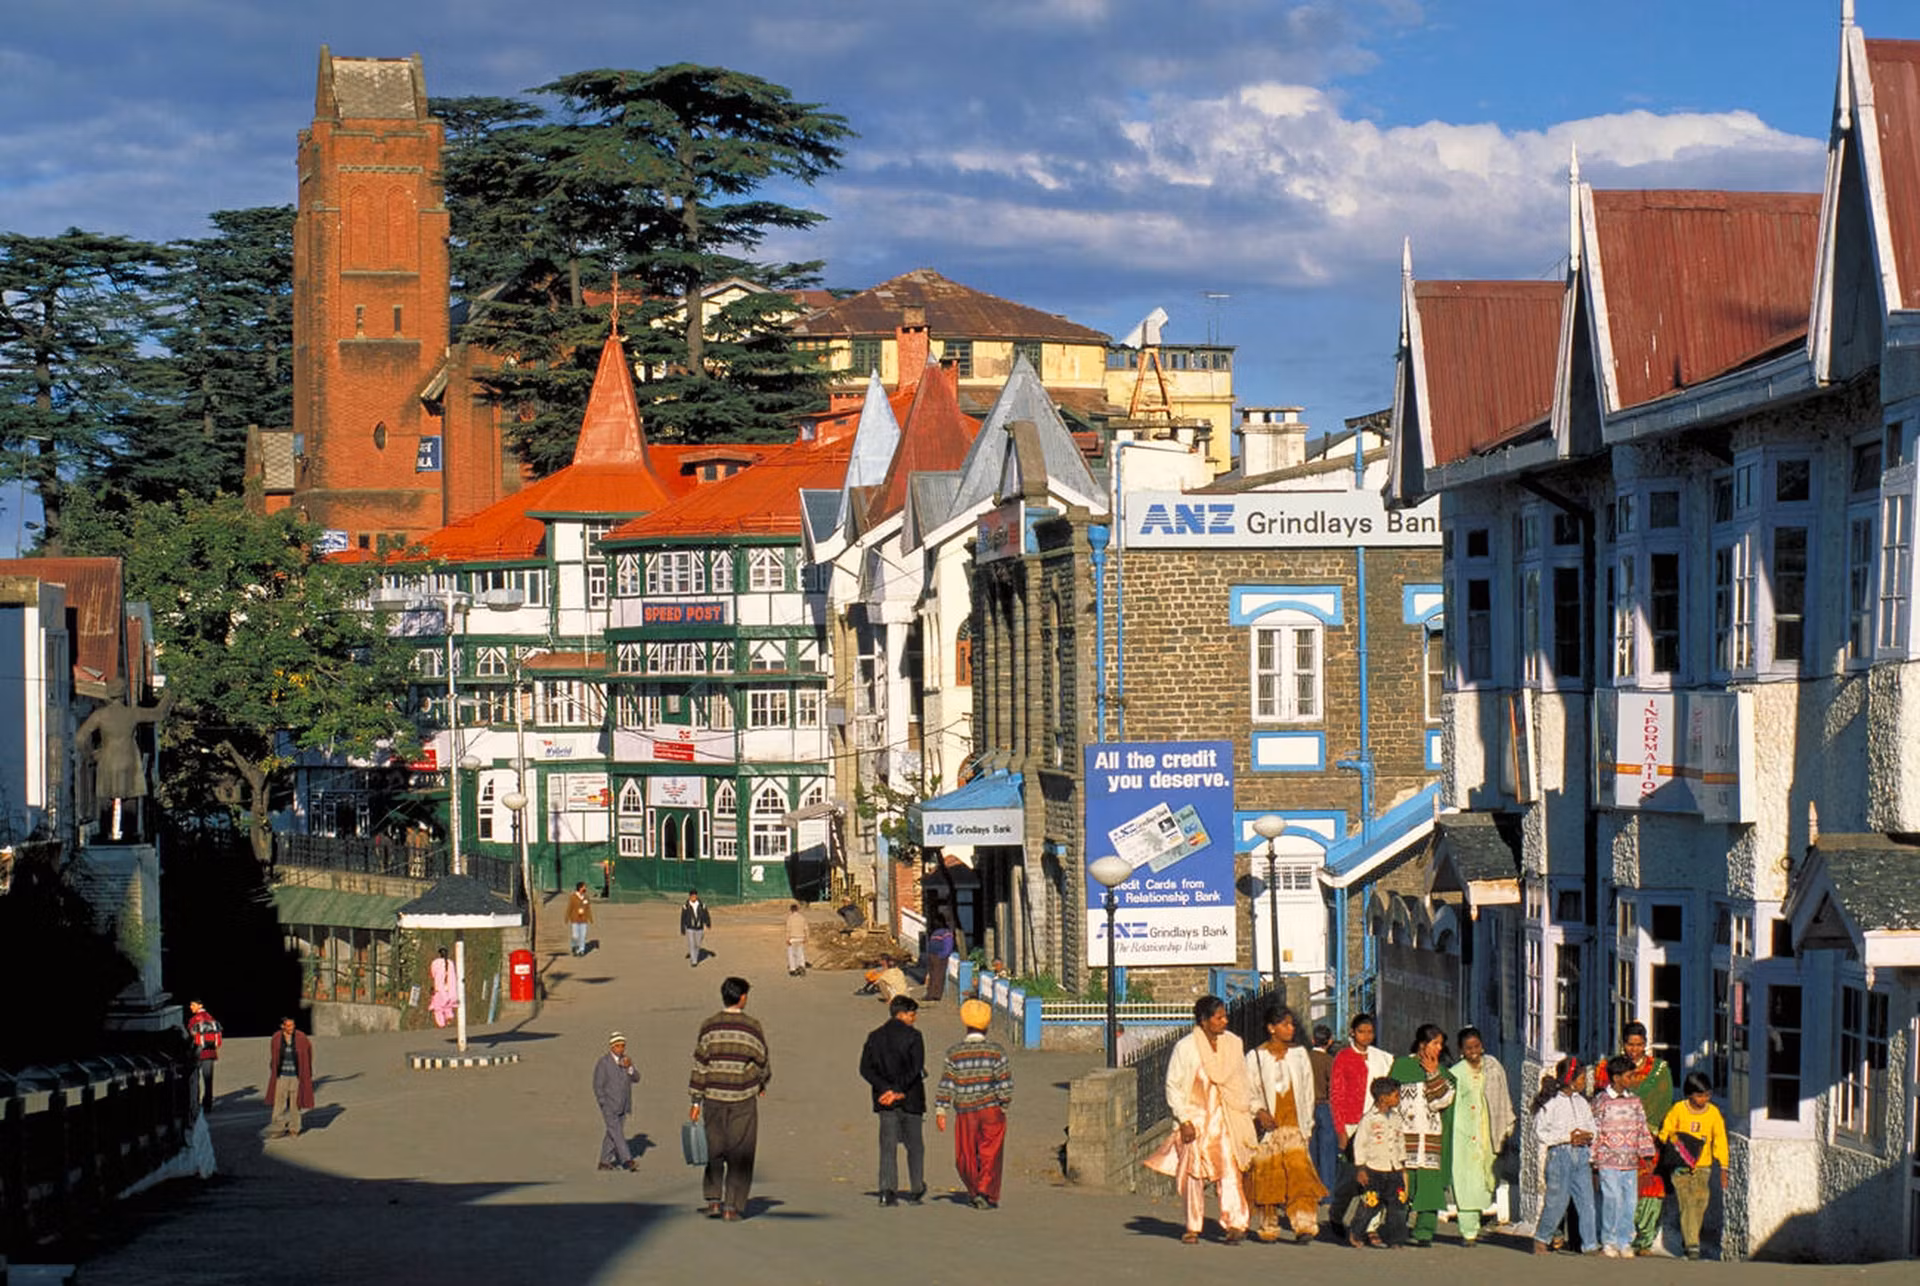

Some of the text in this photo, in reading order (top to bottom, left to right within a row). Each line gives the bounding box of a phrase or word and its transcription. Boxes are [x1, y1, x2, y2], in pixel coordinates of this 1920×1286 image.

[1140, 504, 1235, 534] ANZ
[1247, 511, 1372, 538] Grindlays
[644, 605, 721, 622] SPEED POST
[1095, 749, 1217, 769] All the credit
[1107, 770, 1230, 793] you deserve.
[927, 823, 1012, 836] ANZ Grindlays Bank
[1146, 879, 1177, 890] Cards
[1182, 878, 1205, 889] from
[1099, 891, 1221, 905] Te Relationship Bank
[1150, 927, 1199, 939] Grindlays
[1202, 925, 1229, 937] Bank
[1131, 941, 1183, 953] Relationship
[1185, 940, 1209, 951] Bank
